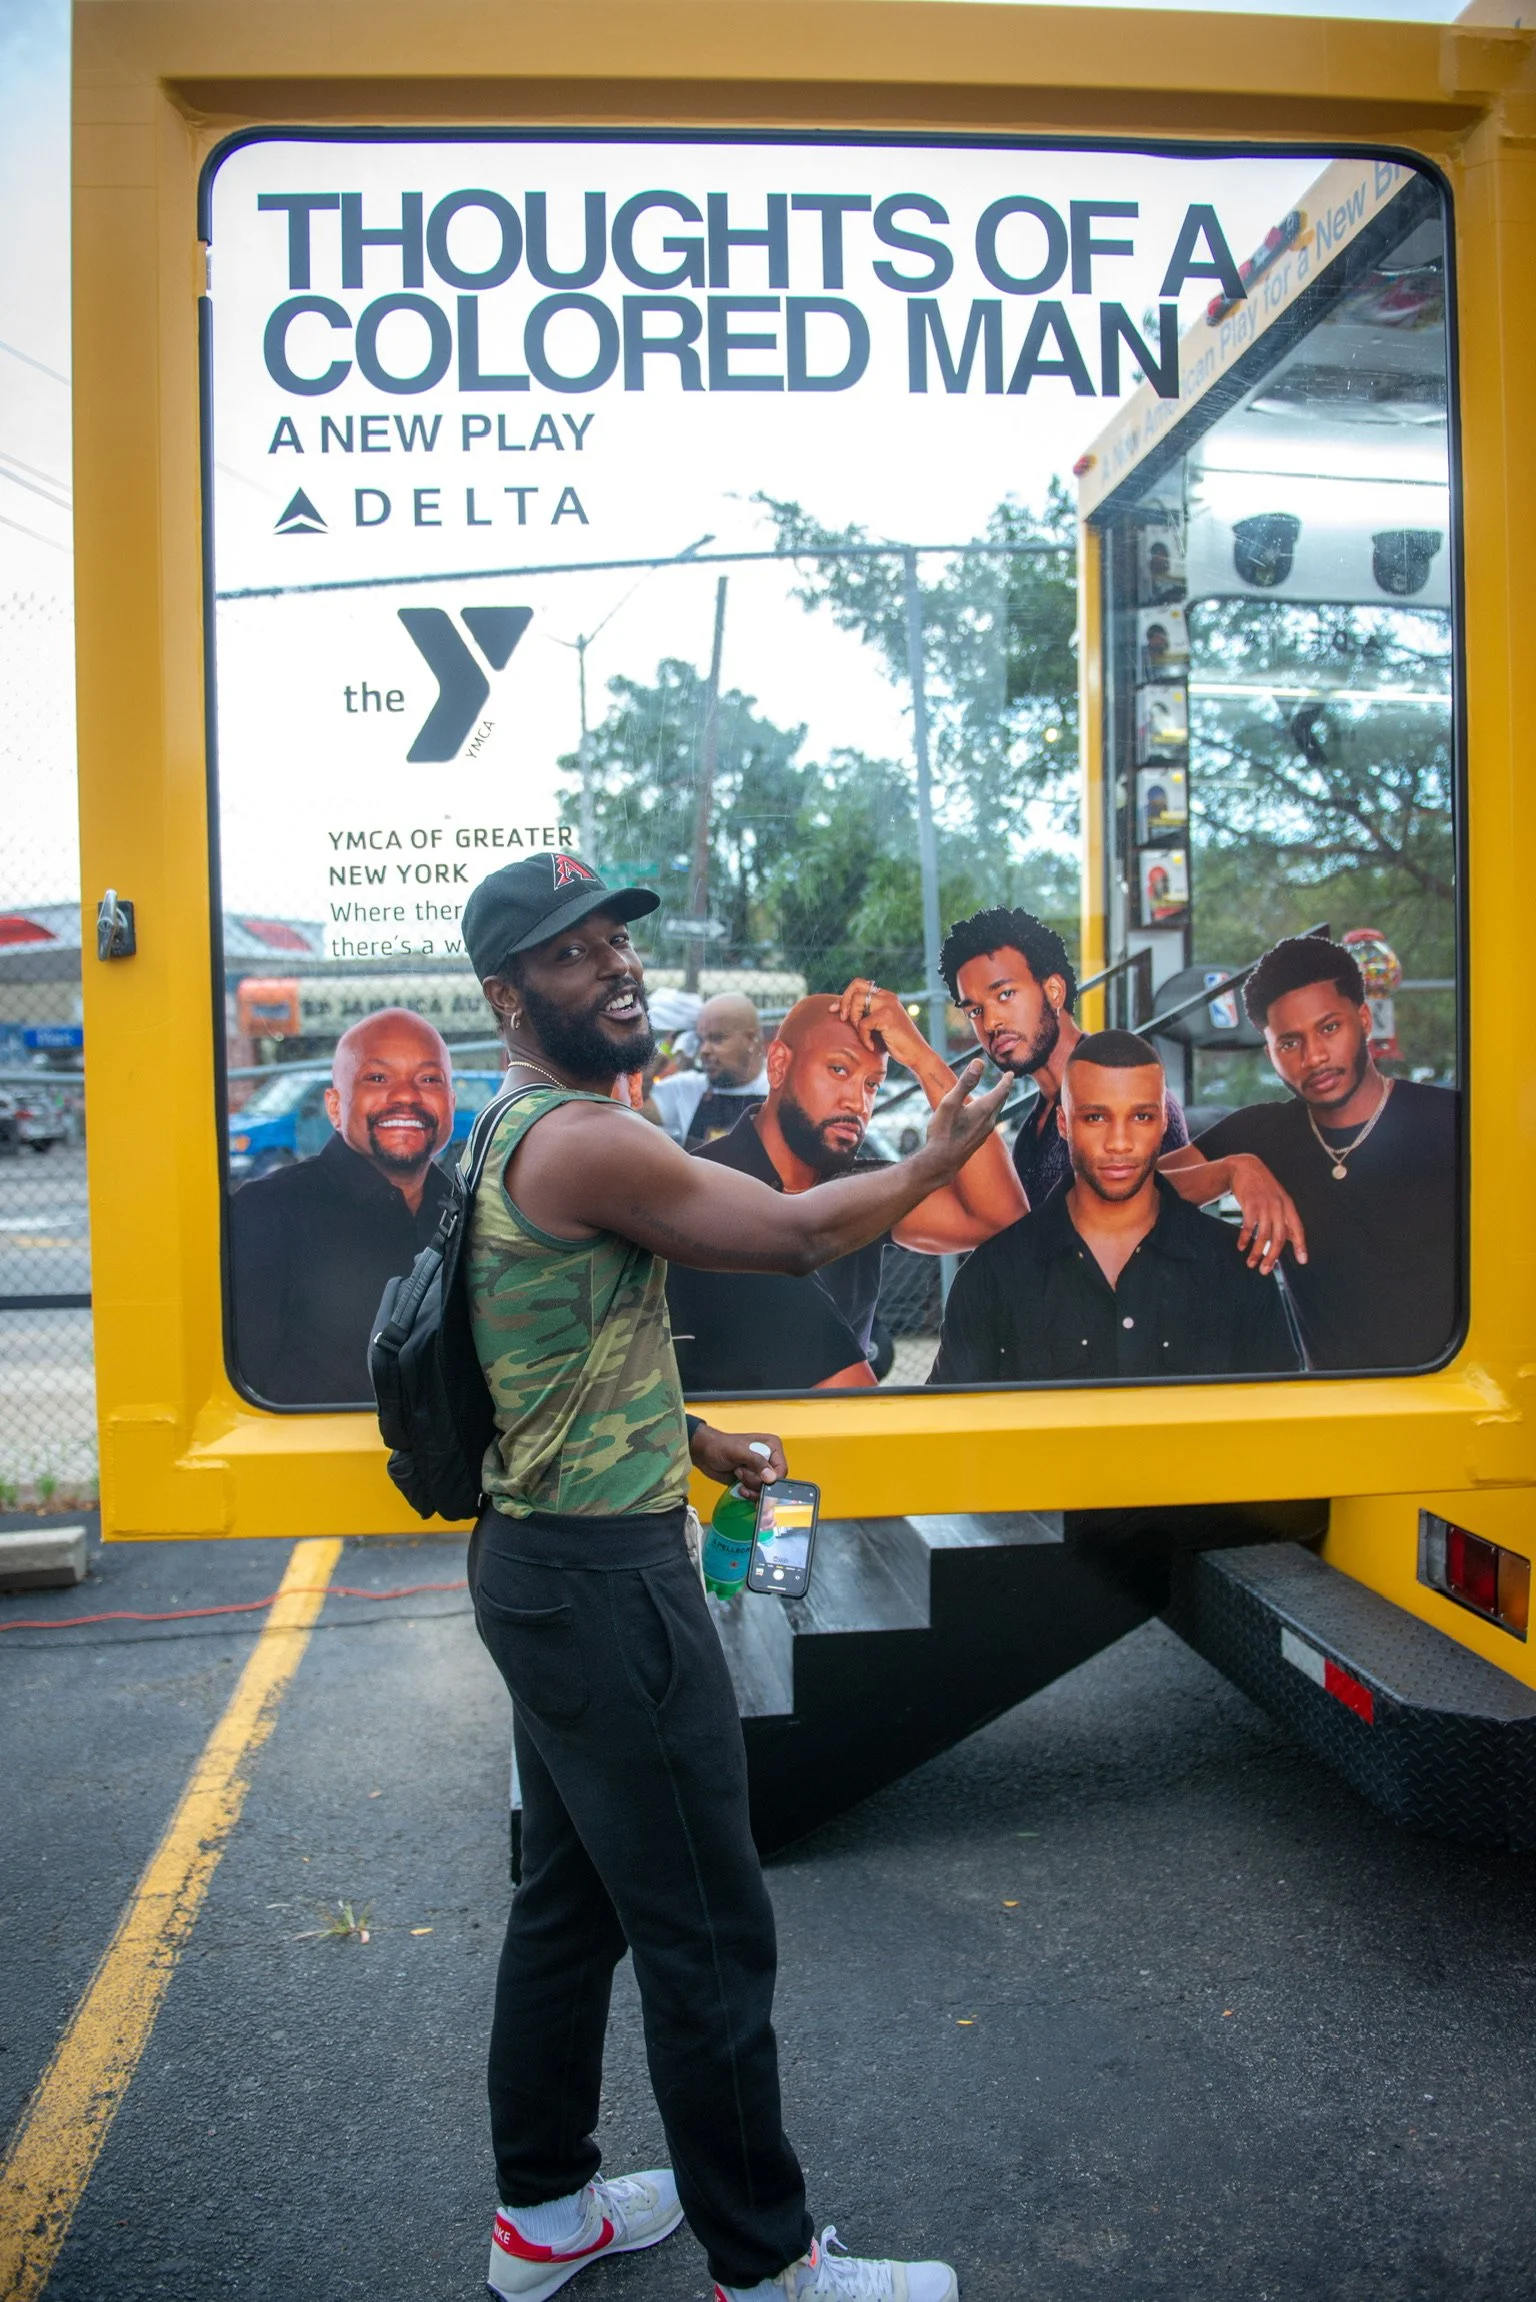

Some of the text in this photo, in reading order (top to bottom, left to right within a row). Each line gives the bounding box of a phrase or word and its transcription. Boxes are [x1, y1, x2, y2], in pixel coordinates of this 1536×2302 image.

[257, 189, 1248, 299] THOUGHTS OF A
[1220, 297, 1258, 361] Play
[1263, 262, 1291, 313] for
[1297, 249, 1310, 281] a
[1315, 181, 1367, 260] New
[263, 292, 1180, 400] COLORED MAN
[268, 413, 595, 454] A NEW PLAY
[354, 486, 590, 527] DELTA
[343, 682, 405, 713] the
[465, 721, 496, 758] YMCA
[328, 826, 574, 851] YMCA OF GREATER
[329, 863, 469, 886] NEW YORK
[331, 902, 405, 922] Where
[332, 935, 411, 957] there's
[422, 940, 434, 954] a
